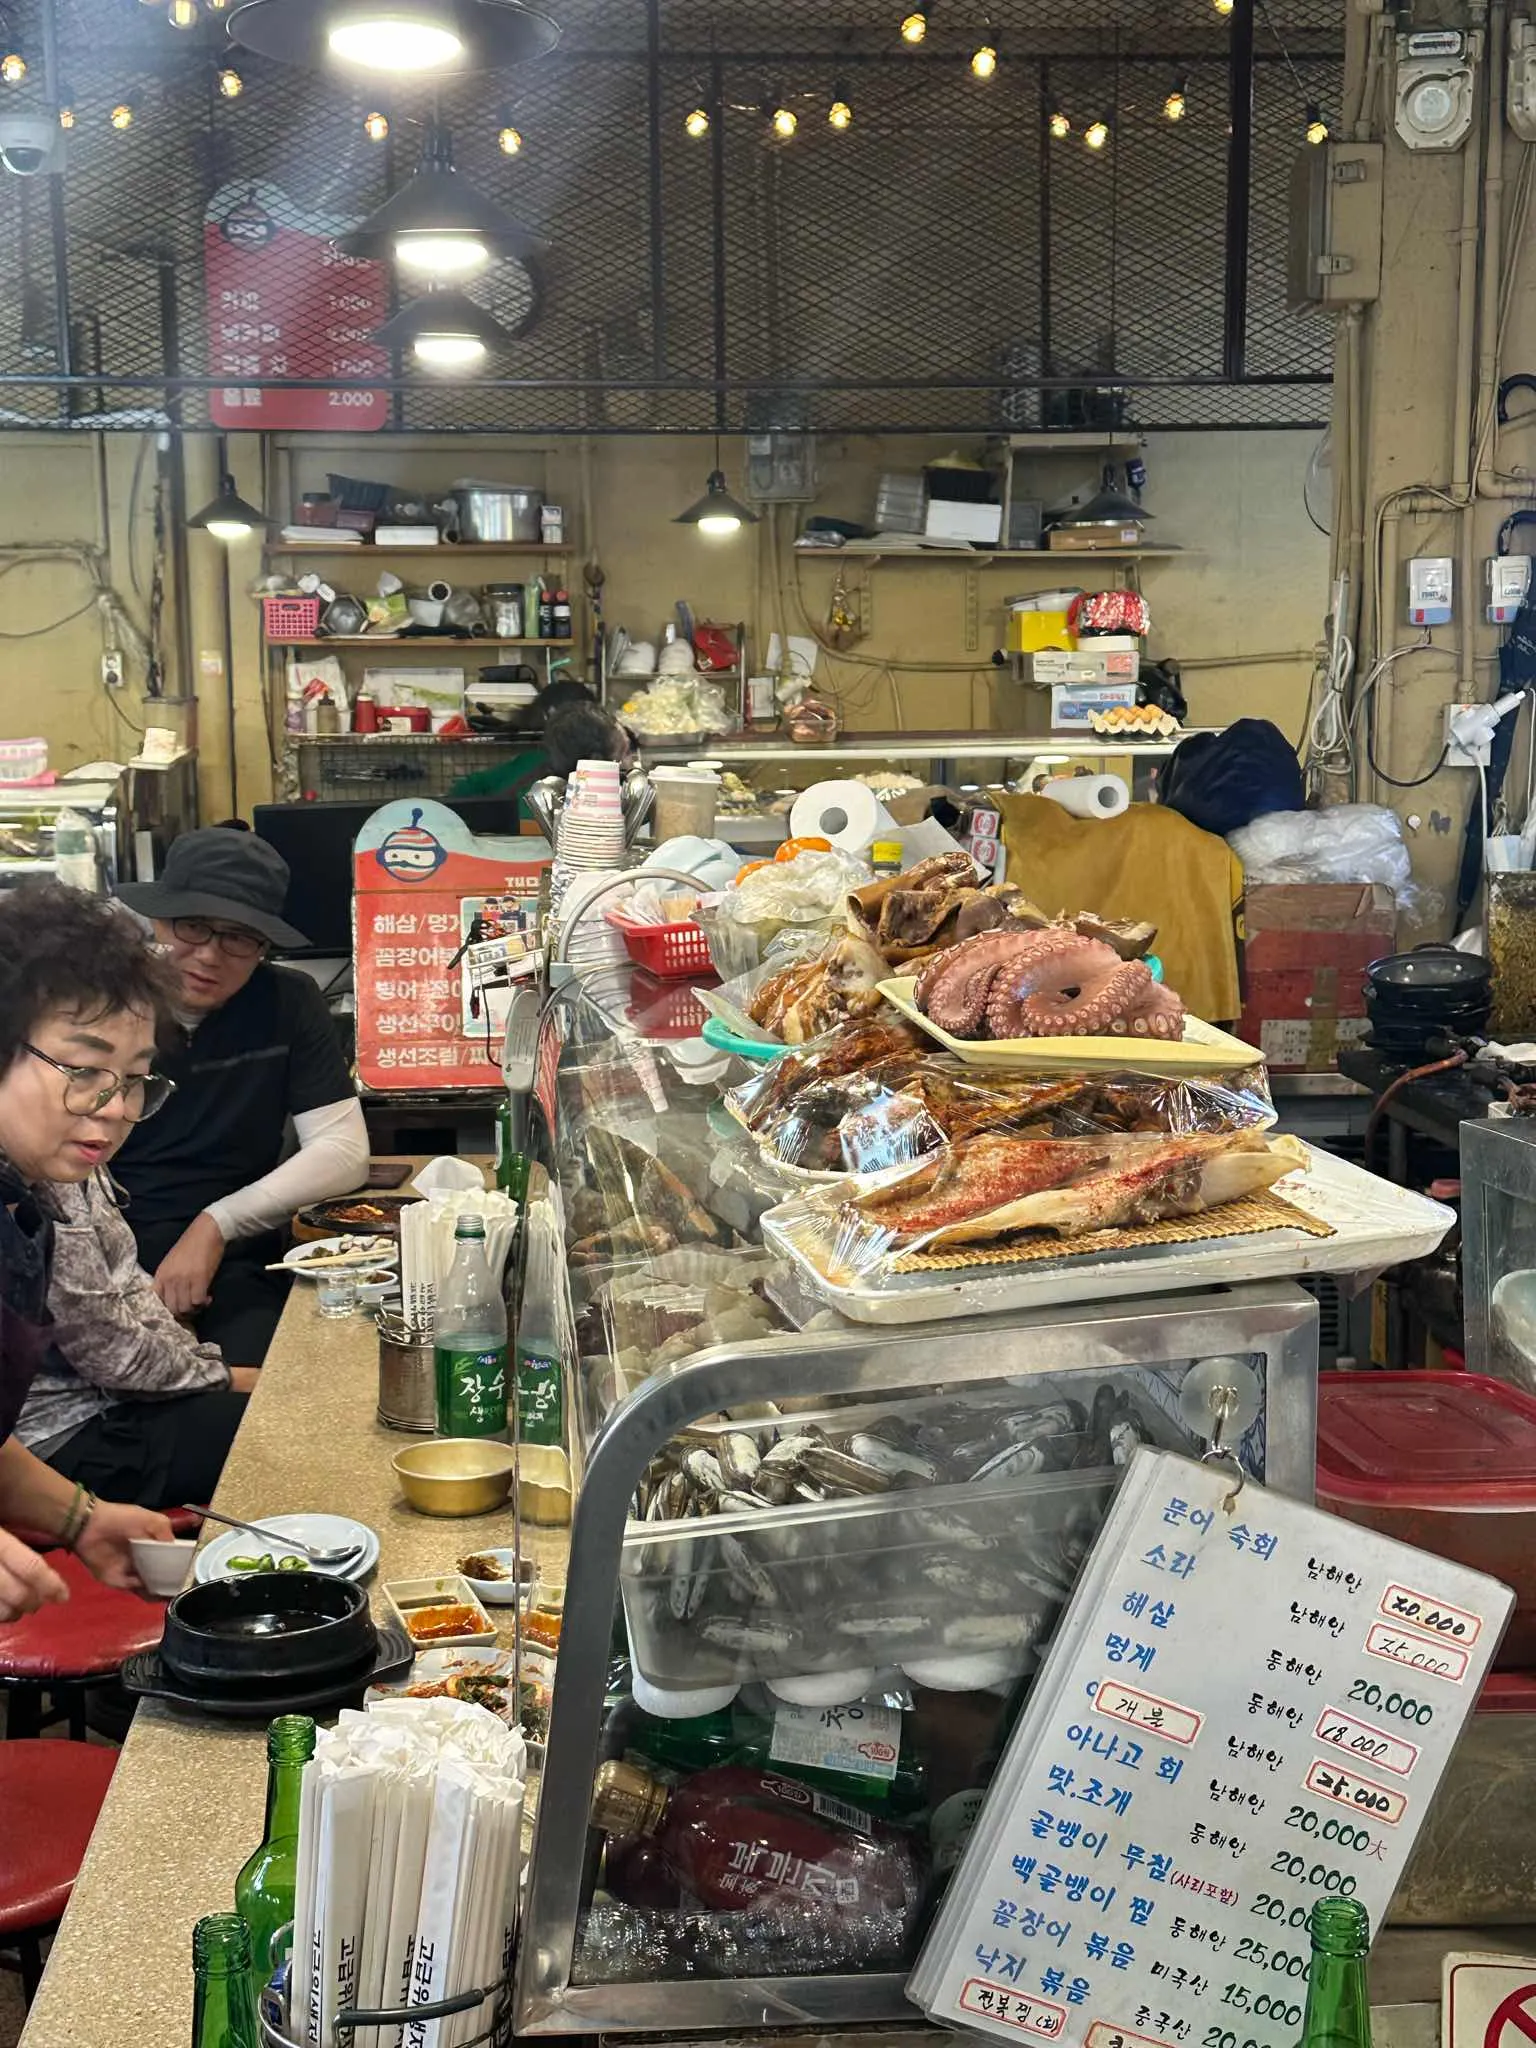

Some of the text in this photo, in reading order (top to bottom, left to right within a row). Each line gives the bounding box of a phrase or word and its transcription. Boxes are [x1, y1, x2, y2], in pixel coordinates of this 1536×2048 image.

[1140, 1544, 1195, 1579] 소라
[1290, 1602, 1345, 1638] 남해안
[1163, 1497, 1214, 1535] 문어
[1228, 1524, 1278, 1560] 숙회
[1307, 1558, 1362, 1593] 남해안
[1106, 1633, 1156, 1672] 멍게
[1246, 1693, 1303, 1728] 동해안
[1122, 1592, 1433, 1725] 해삼 동해안 20,000
[1067, 1725, 1143, 1769] 아나고
[1155, 1757, 1183, 1784] 회
[1210, 1779, 1264, 1815] 남해안
[1228, 1736, 1283, 1771] 남해안
[1012, 1855, 1116, 1912] 백골뱅이
[1170, 1916, 1227, 1951] 동해안
[1030, 1810, 1108, 1858] 골뱅이
[1251, 1894, 1312, 1933] 20,0
[1190, 1823, 1246, 1858] 동해안
[1271, 1851, 1356, 1896] 20,000
[976, 1944, 1026, 1982] 낙지
[1040, 1967, 1090, 2005] 볶음
[1135, 2005, 1191, 2040] 중국산
[992, 1899, 1301, 2026] 꼼장어 볶음 미국산 15,000
